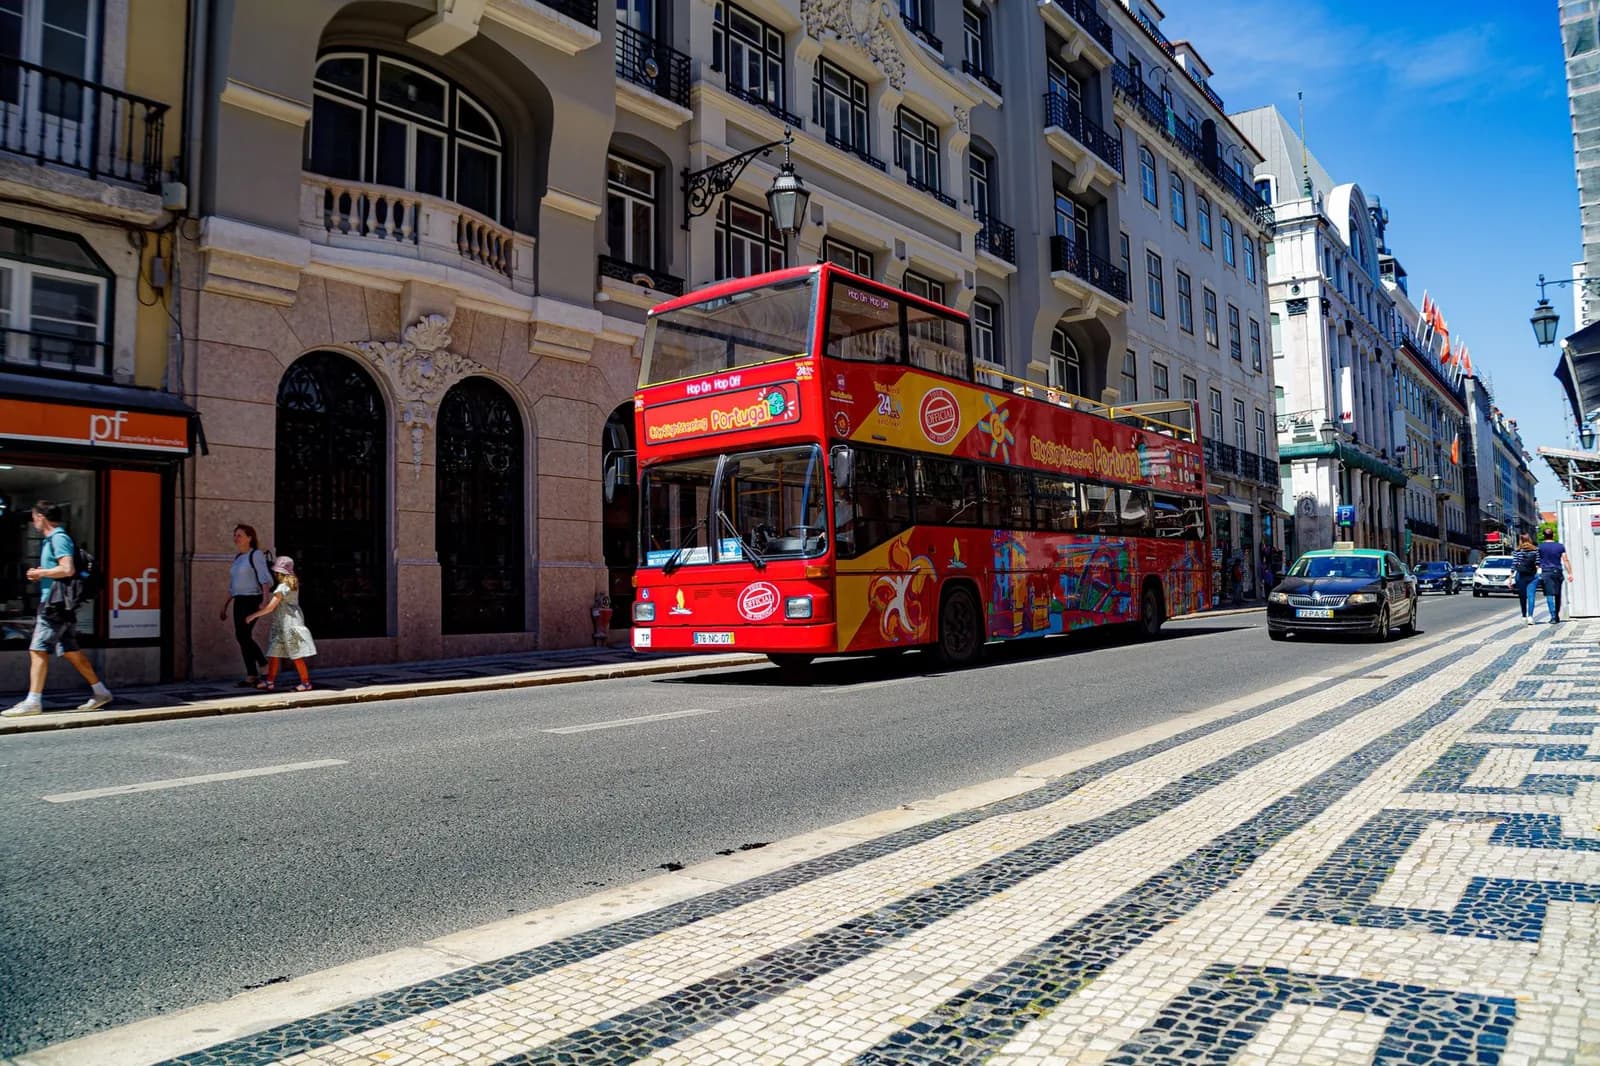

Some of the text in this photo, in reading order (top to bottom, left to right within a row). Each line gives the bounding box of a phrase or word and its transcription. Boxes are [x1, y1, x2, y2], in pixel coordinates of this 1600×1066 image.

[847, 289, 859, 301] Hop
[869, 295, 880, 307] Hop
[687, 375, 742, 395] Hop On Hop Off
[711, 400, 773, 430] Portugal
[927, 407, 954, 424] OFFICIAL
[90, 410, 128, 445] pf
[1093, 438, 1141, 483] Portugal
[1342, 511, 1350, 520] P
[113, 567, 159, 618] pf
[641, 634, 650, 642] TP
